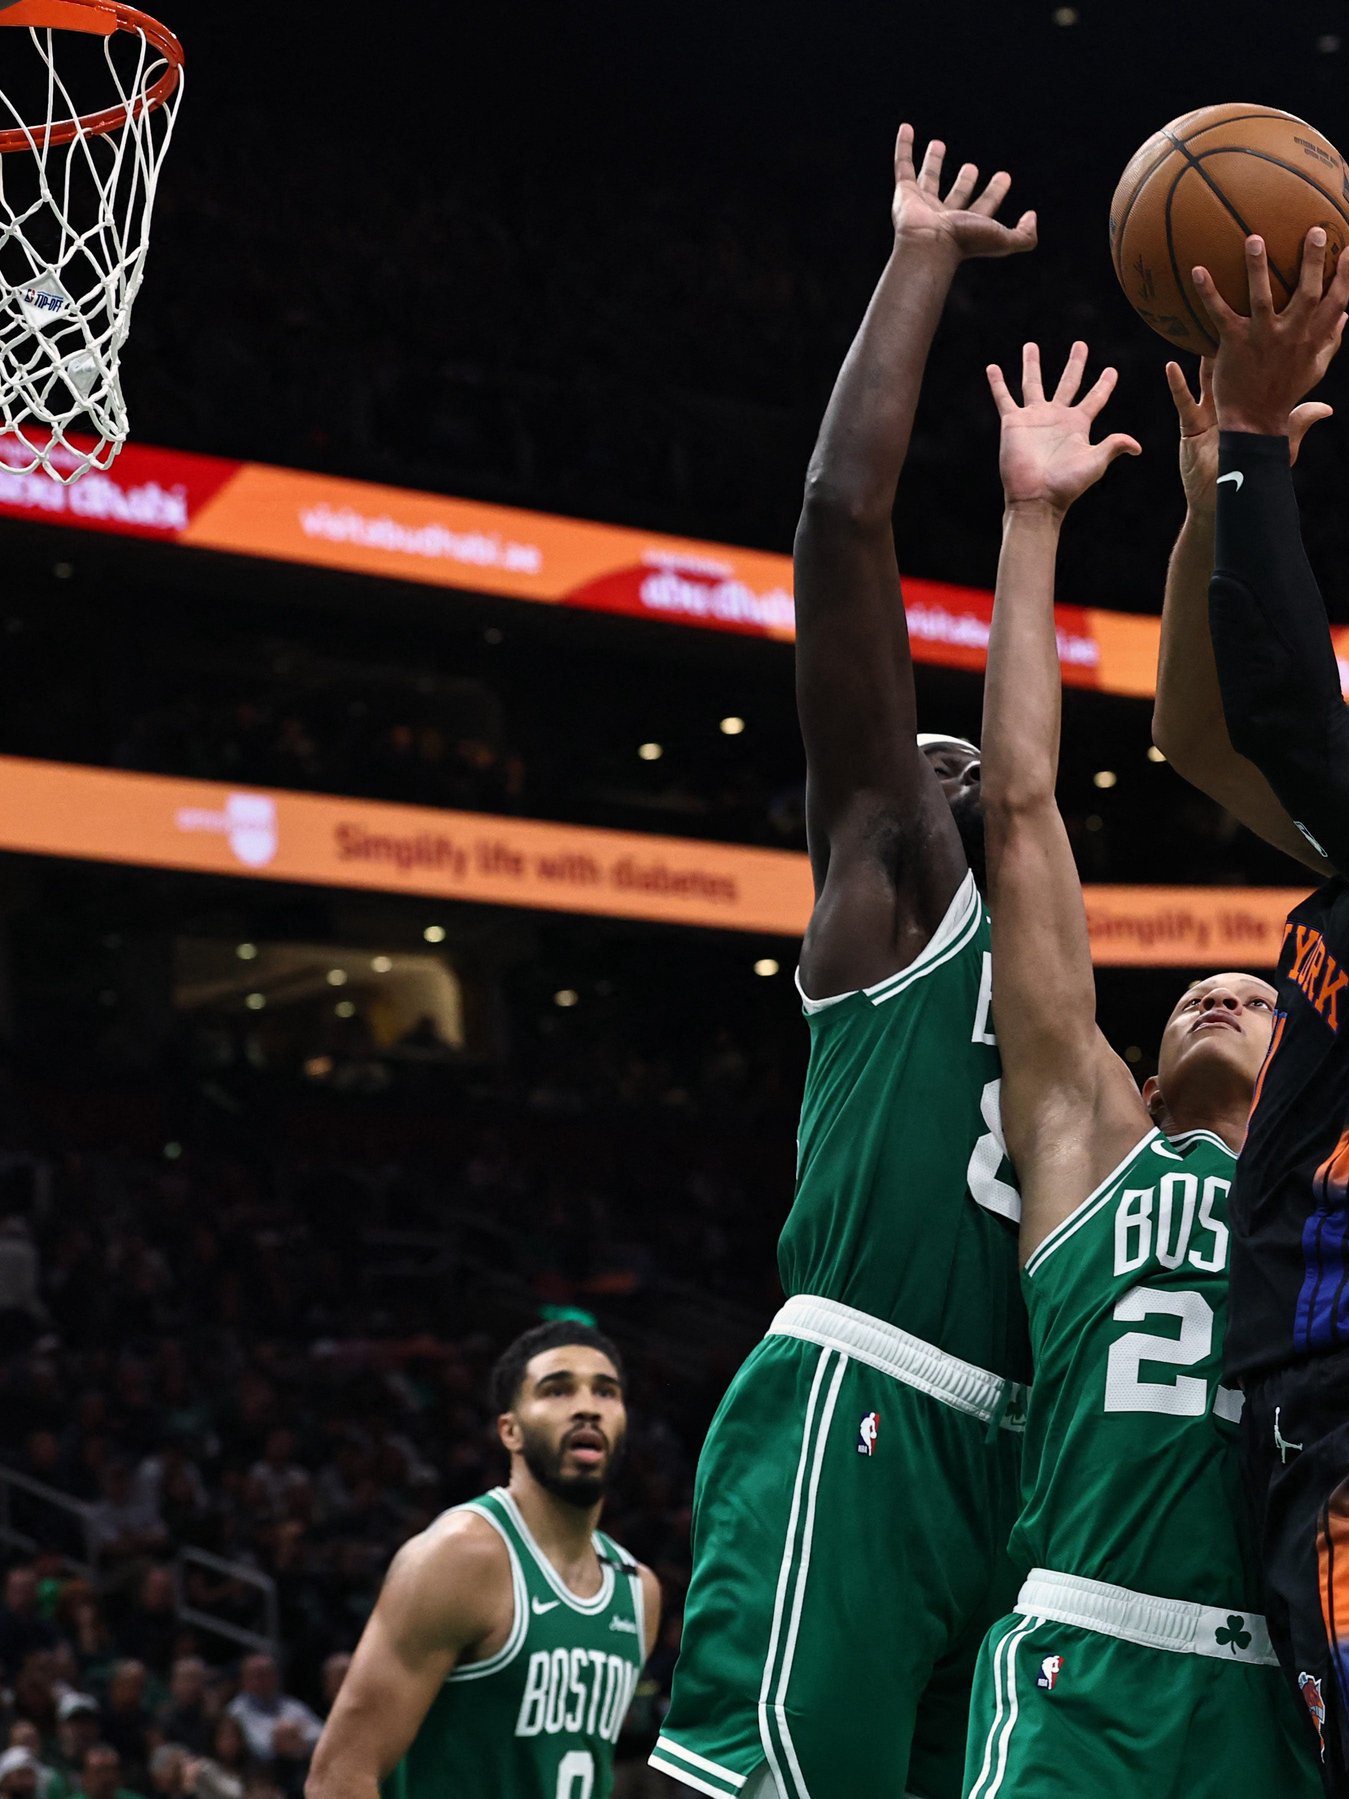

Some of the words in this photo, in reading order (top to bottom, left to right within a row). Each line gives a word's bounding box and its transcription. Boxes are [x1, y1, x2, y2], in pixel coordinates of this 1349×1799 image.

[34, 293, 64, 313] TIP-OFF
[334, 820, 468, 885] Simplify
[474, 838, 525, 882] life
[537, 850, 600, 887] with
[610, 855, 739, 904] diabetes
[1103, 1285, 1246, 1424] 2
